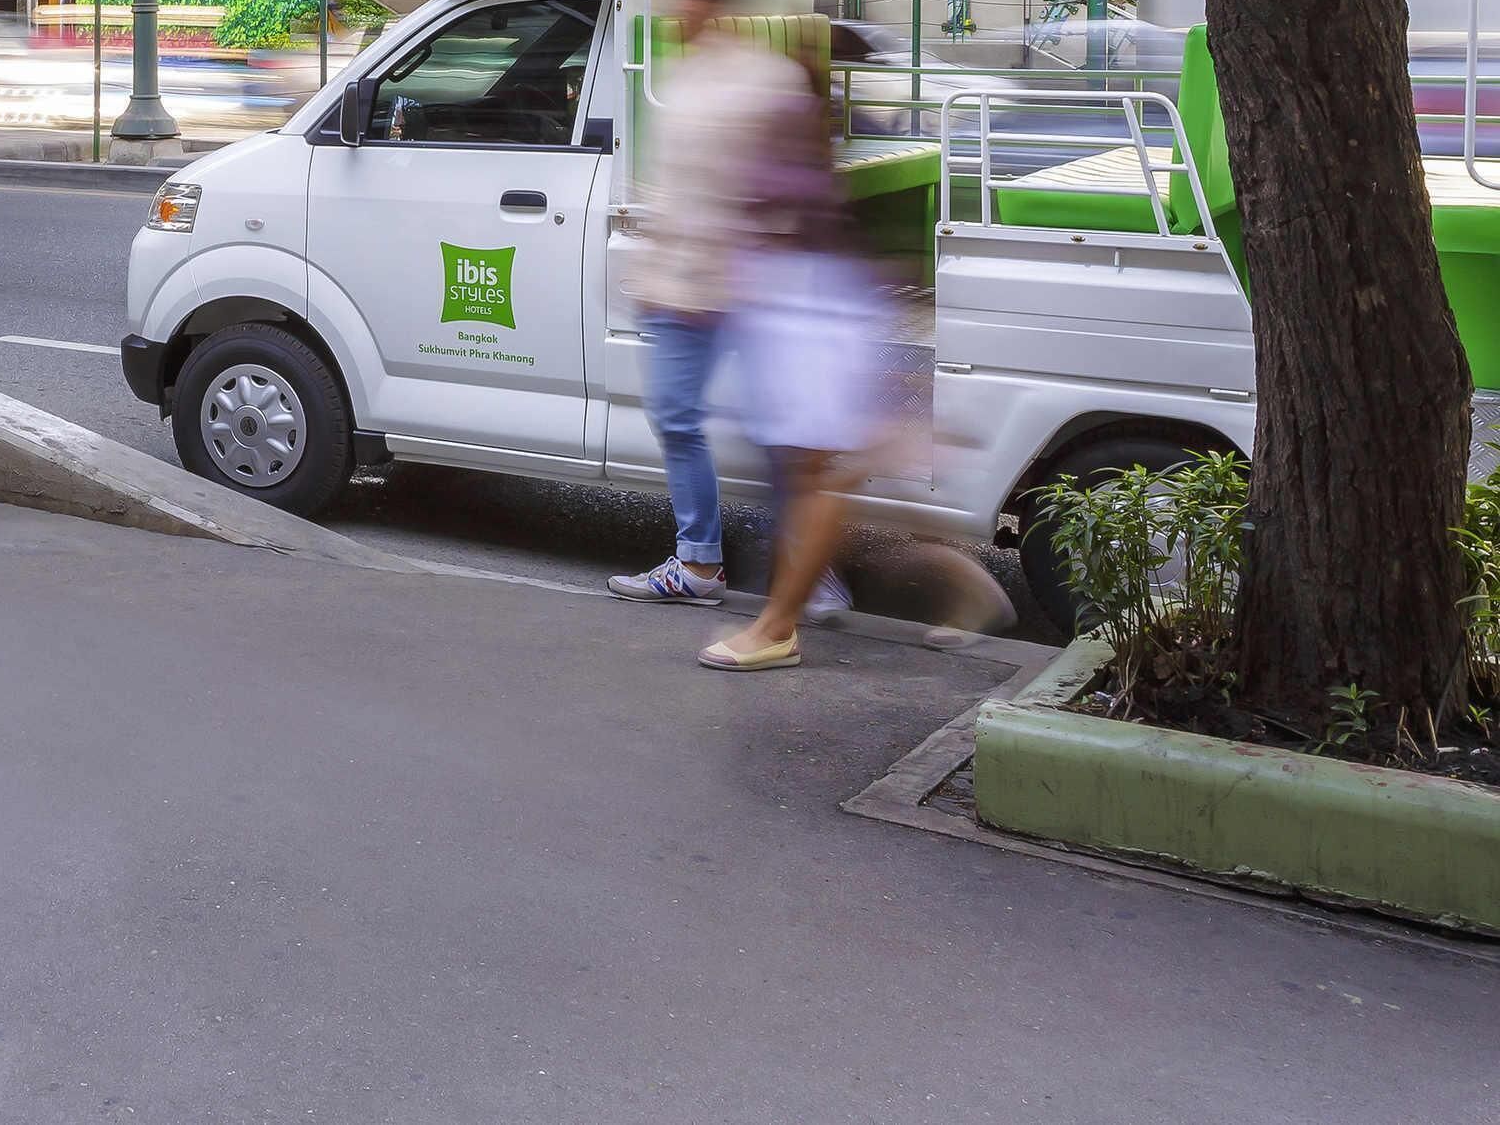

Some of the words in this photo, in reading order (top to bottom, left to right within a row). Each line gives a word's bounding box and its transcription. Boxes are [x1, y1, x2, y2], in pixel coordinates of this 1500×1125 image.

[457, 258, 498, 286] ibis
[464, 305, 492, 315] HOTELS
[457, 331, 499, 345] Bangkok
[418, 343, 467, 357] Sukhumvit
[469, 348, 490, 360] Phra
[492, 351, 535, 366] Khanong
